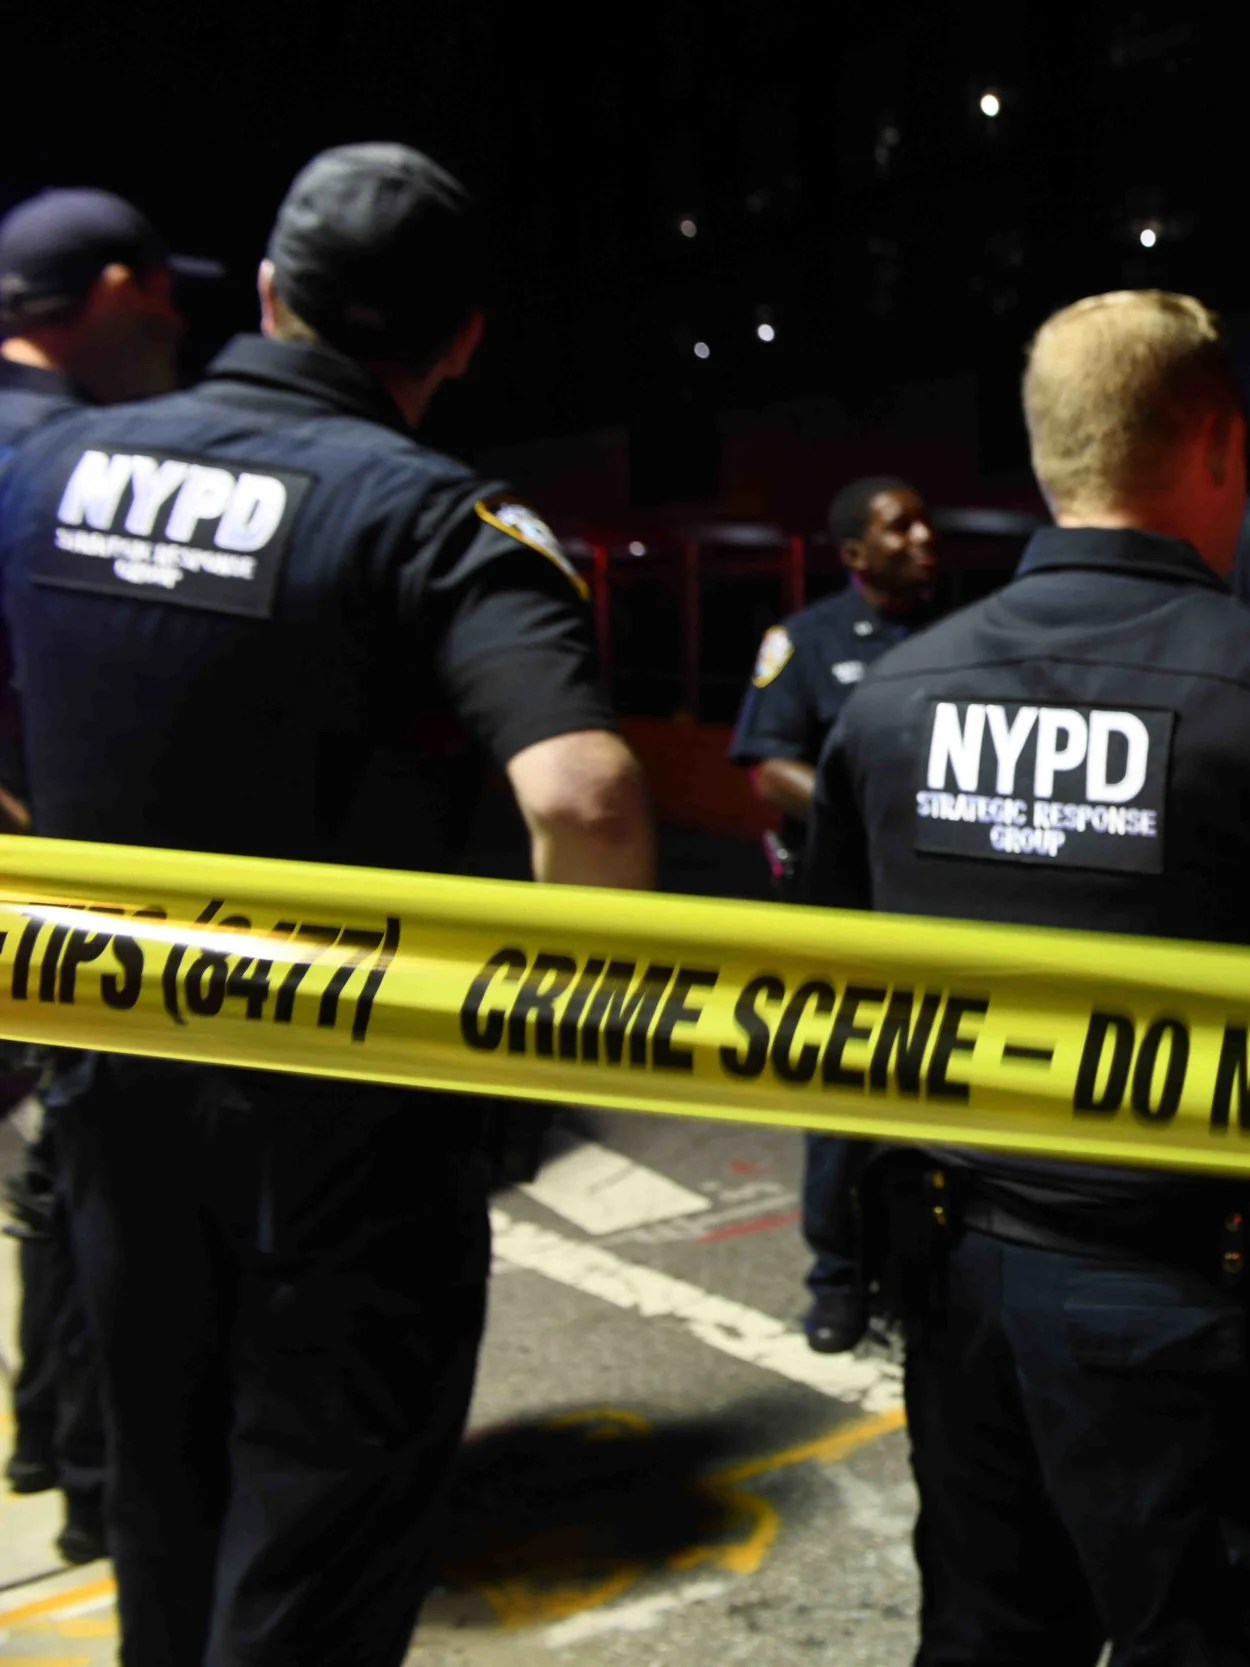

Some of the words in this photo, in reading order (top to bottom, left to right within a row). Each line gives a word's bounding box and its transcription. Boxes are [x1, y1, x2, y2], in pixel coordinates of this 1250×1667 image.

[57, 450, 287, 552] NYPD
[927, 702, 1149, 803] NYPD
[916, 791, 1028, 827] STRATEGIC
[1033, 800, 1157, 837] RESPONSE
[989, 826, 1066, 857] GROUP
[163, 897, 400, 1042] (8477)
[460, 946, 720, 1072] CRIME
[719, 973, 990, 1104] SCENE
[1073, 1005, 1190, 1122] DO
